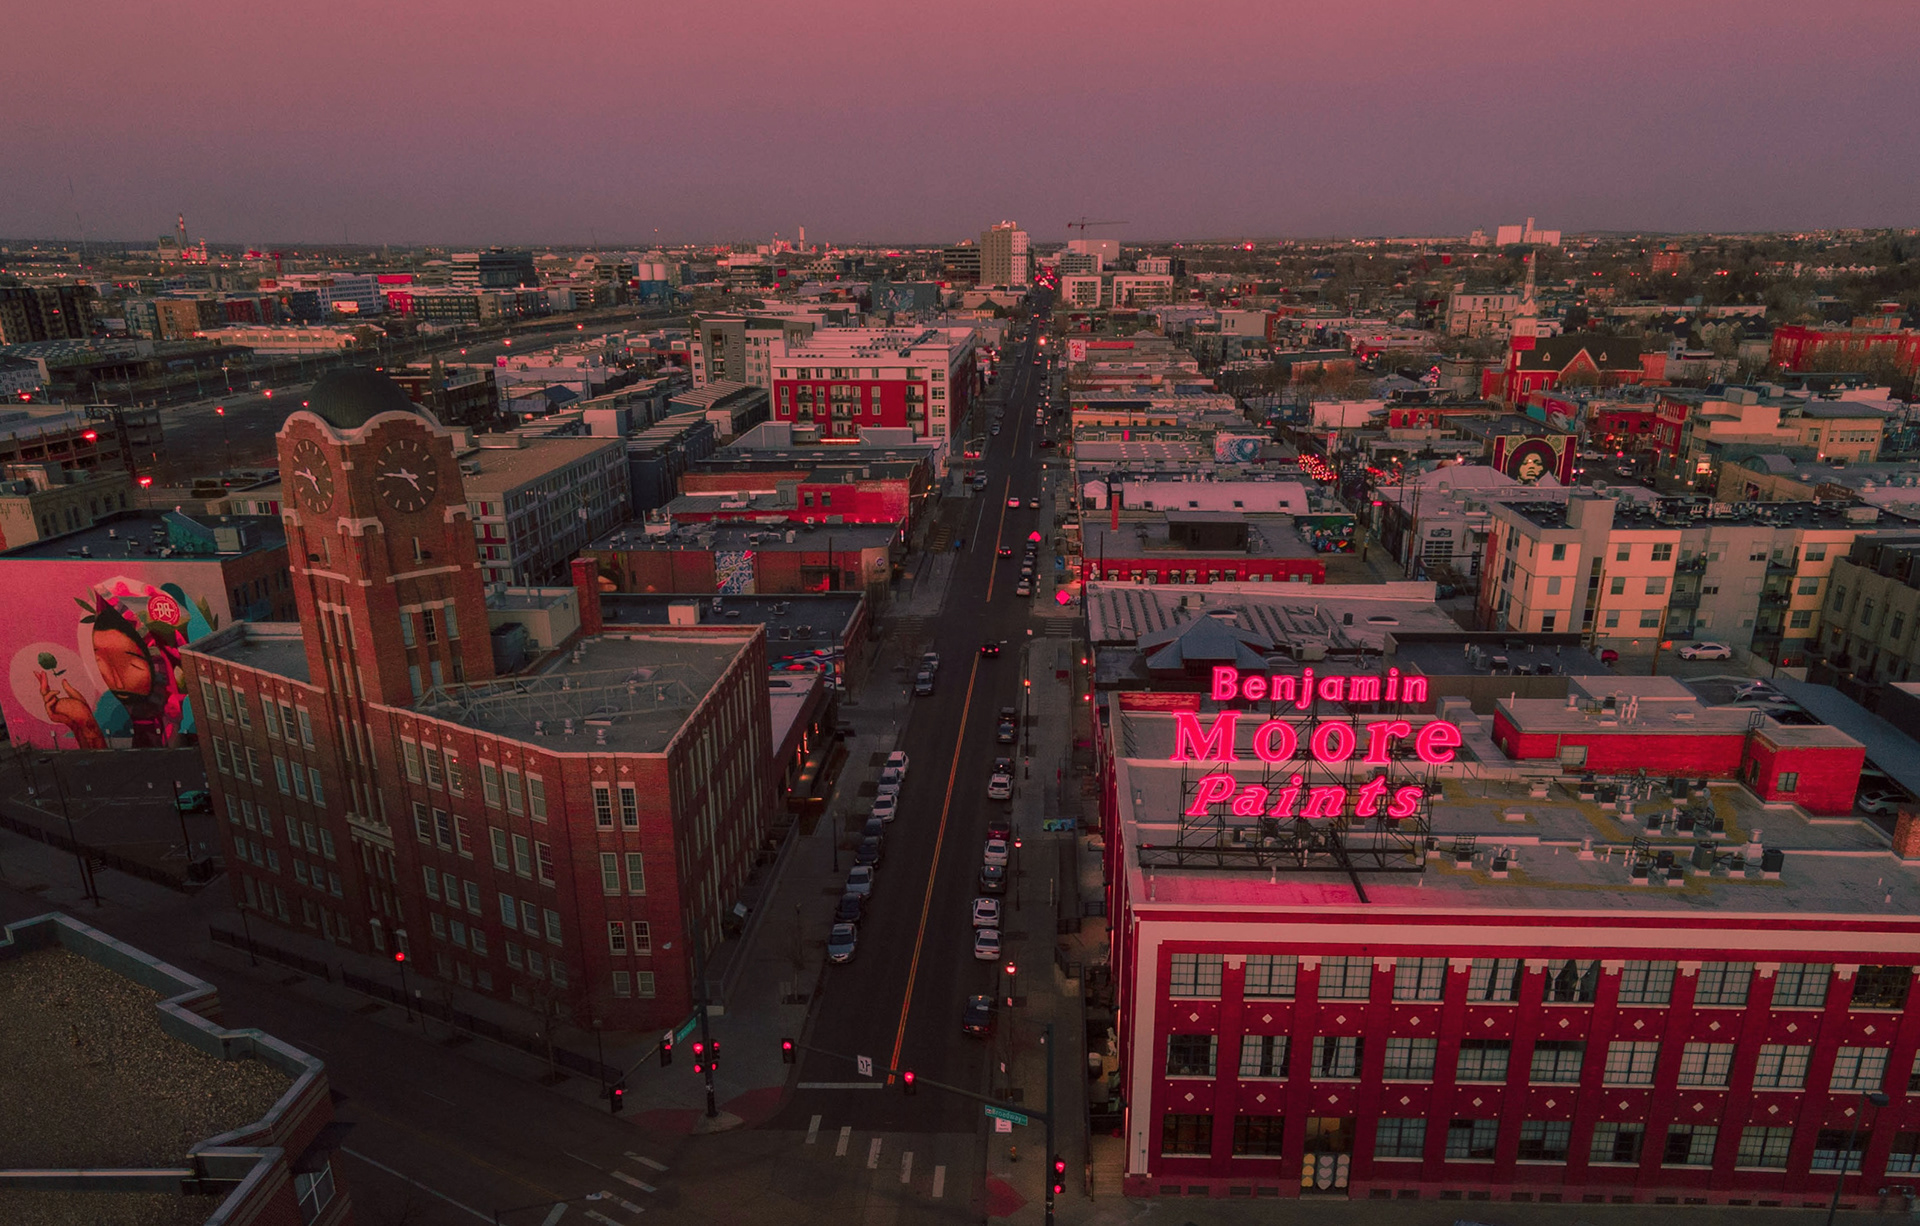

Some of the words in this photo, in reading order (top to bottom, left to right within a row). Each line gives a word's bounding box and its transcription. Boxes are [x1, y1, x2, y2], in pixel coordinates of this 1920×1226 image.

[1212, 666, 1429, 709] Benjamin
[1170, 710, 1462, 764] Moore
[1185, 773, 1424, 819] Paints
